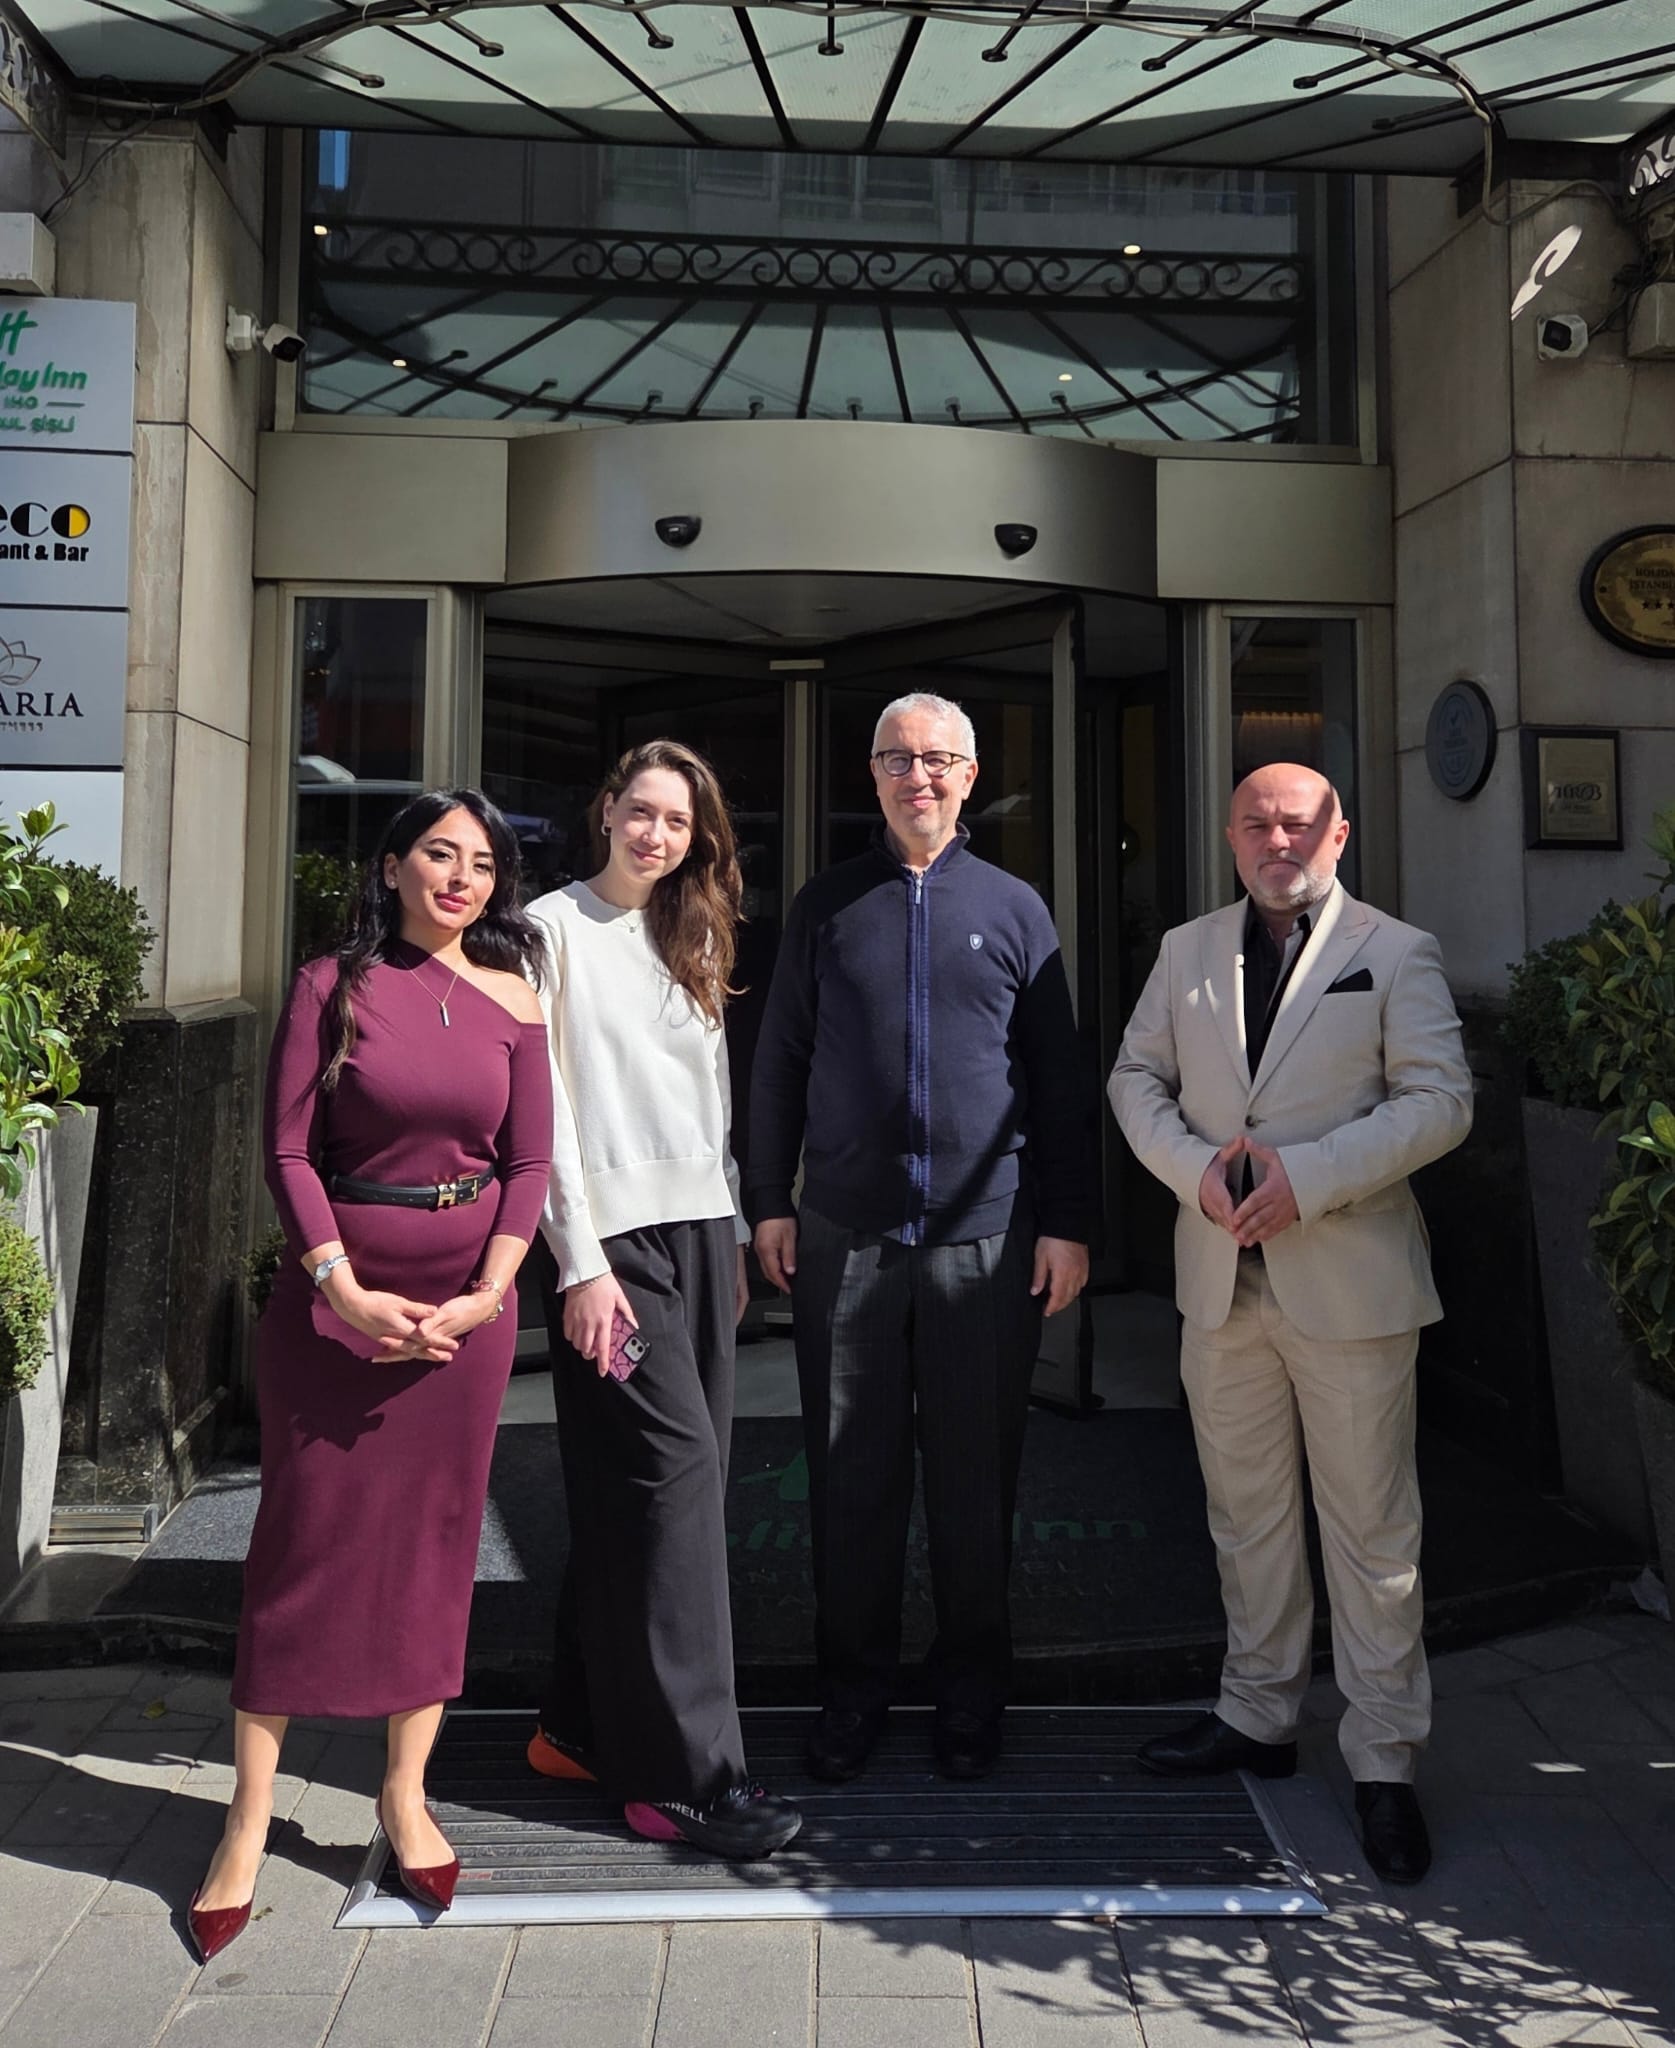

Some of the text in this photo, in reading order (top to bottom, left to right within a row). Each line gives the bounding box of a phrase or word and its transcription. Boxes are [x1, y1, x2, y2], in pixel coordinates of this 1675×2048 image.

[41, 362, 88, 390] Inn
[0, 502, 91, 539] co
[34, 545, 49, 561] &
[54, 543, 89, 562] Bar
